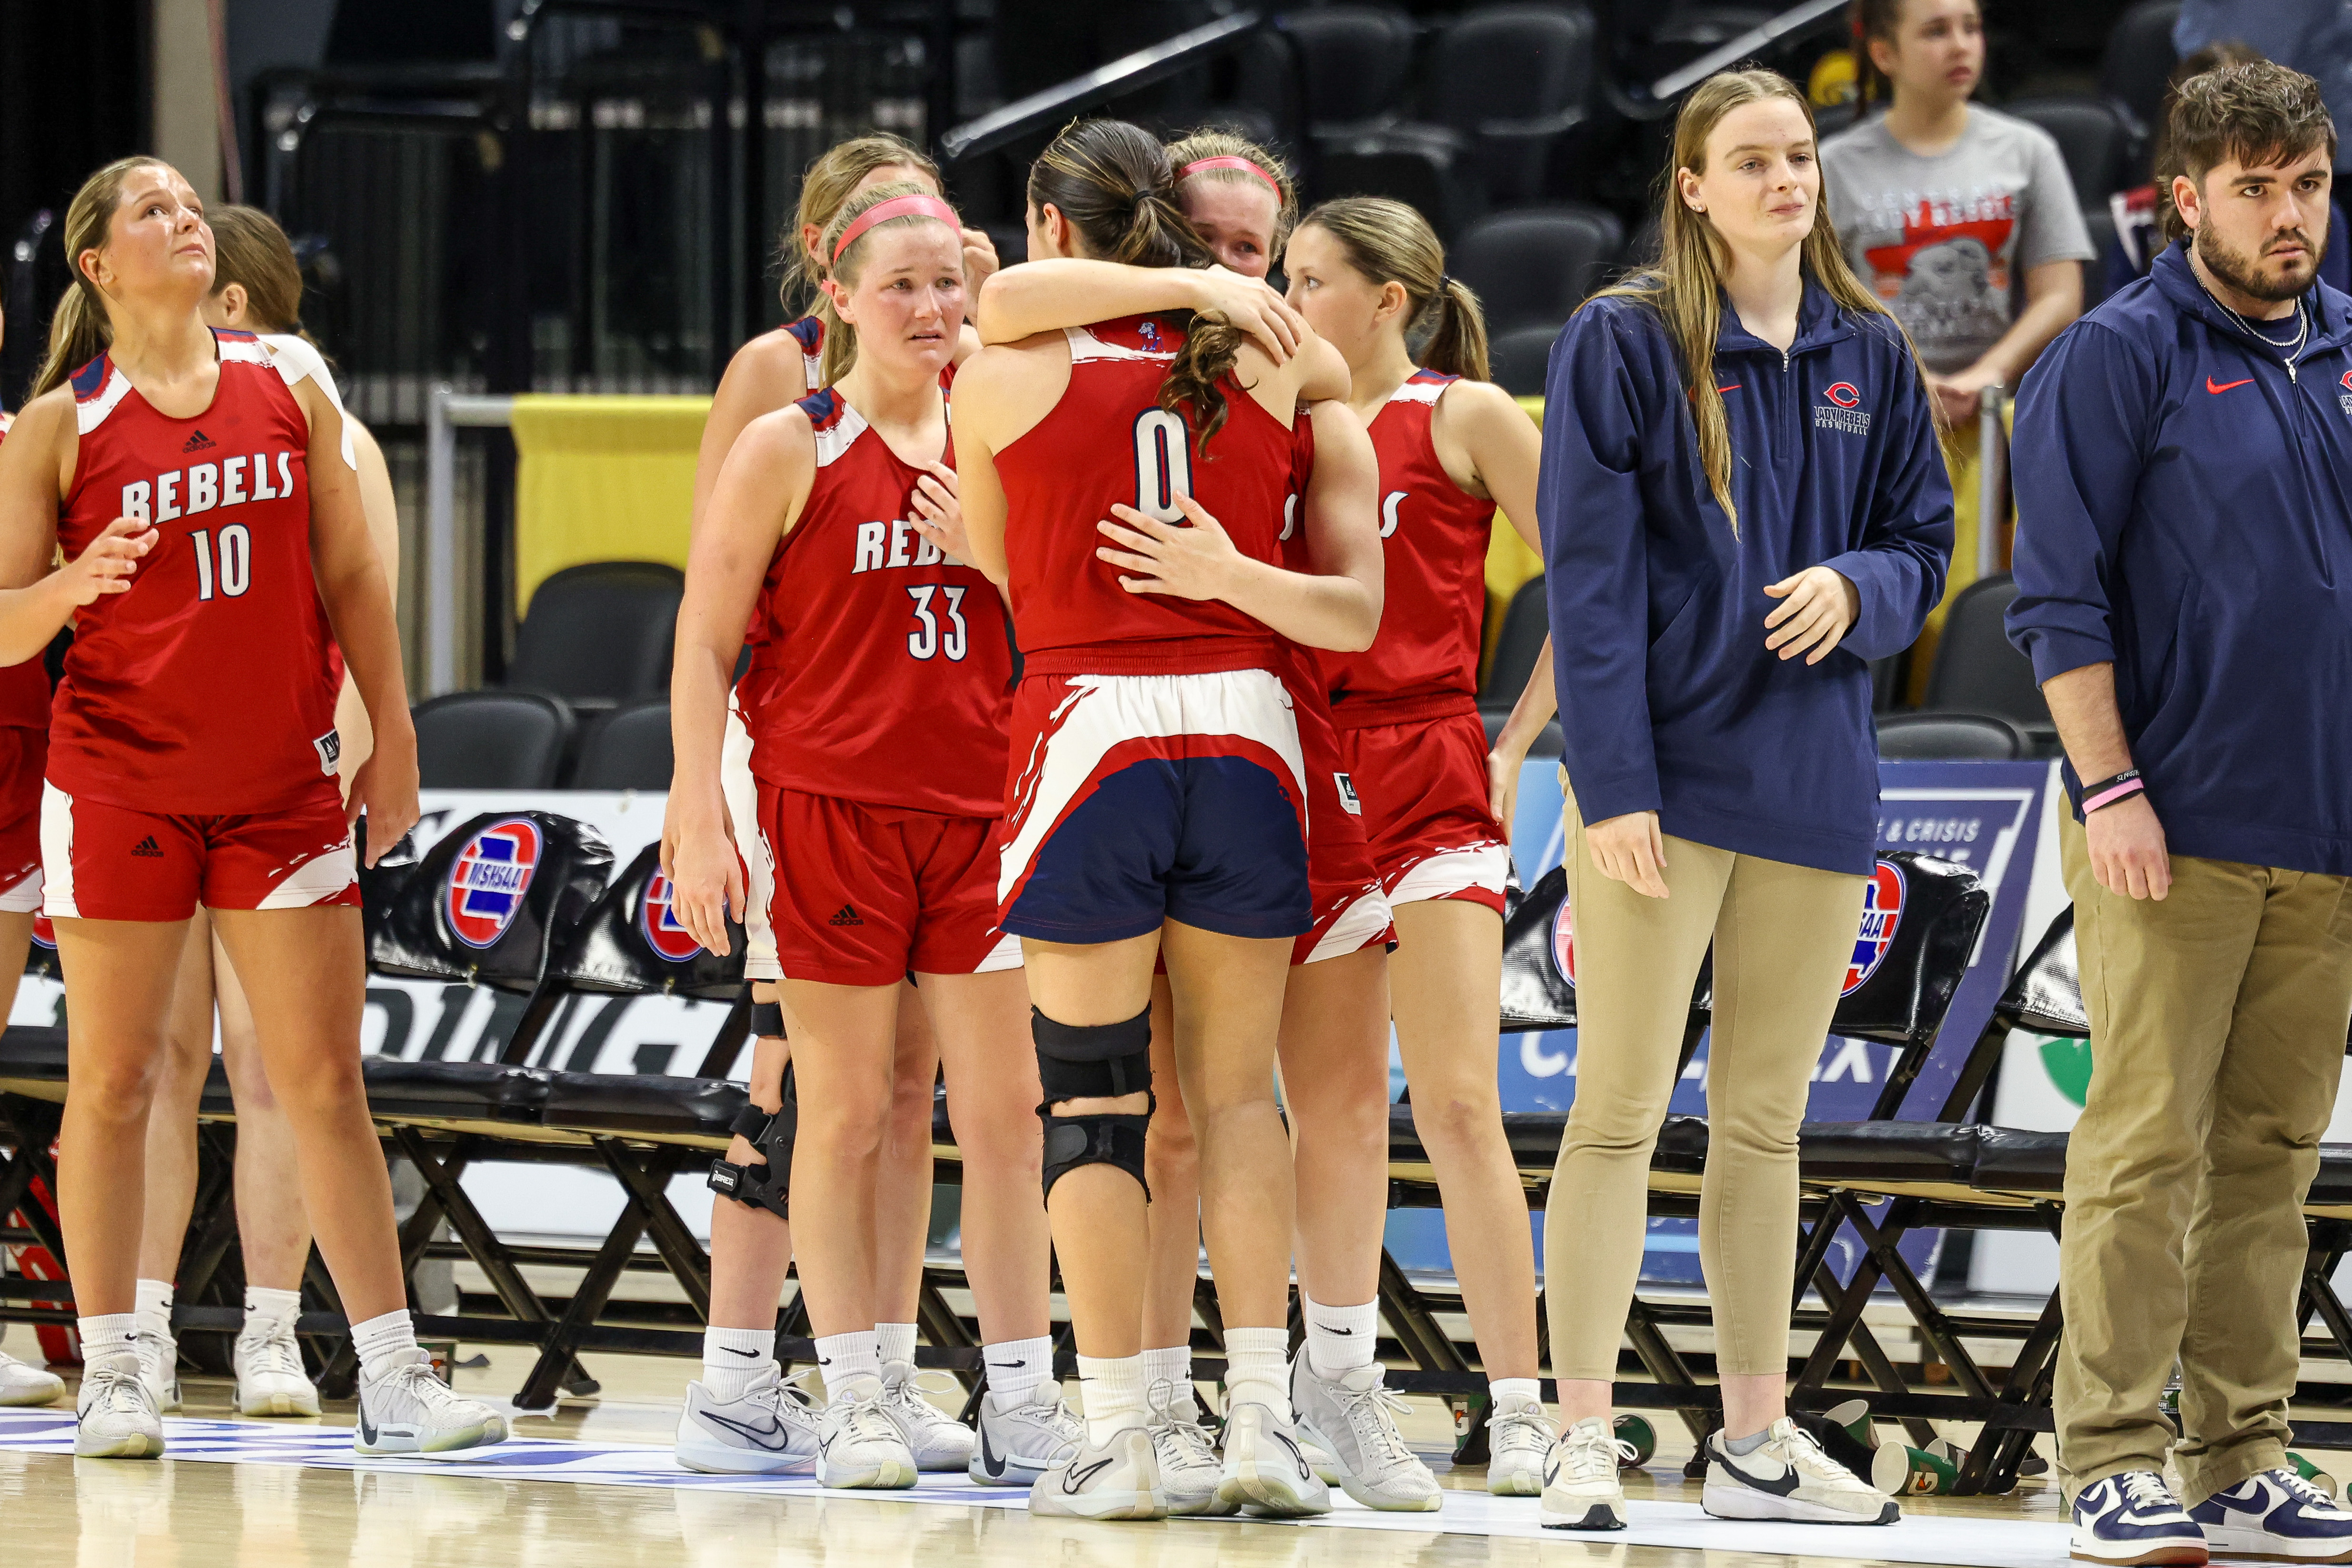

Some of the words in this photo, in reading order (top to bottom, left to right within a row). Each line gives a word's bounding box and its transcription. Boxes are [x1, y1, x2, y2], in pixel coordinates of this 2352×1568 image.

[1814, 406, 1838, 422] LADY
[1839, 409, 1871, 429] REBELS
[182, 441, 217, 454] adidas
[1132, 406, 1194, 526] 0
[122, 450, 294, 526] REBELS
[187, 522, 252, 601] 10
[904, 583, 969, 663] 33
[1905, 817, 1982, 843] CRISIS
[829, 918, 864, 926] adidas
[716, 1173, 734, 1187] BREG
[1561, 1429, 1571, 1444] NIKE
